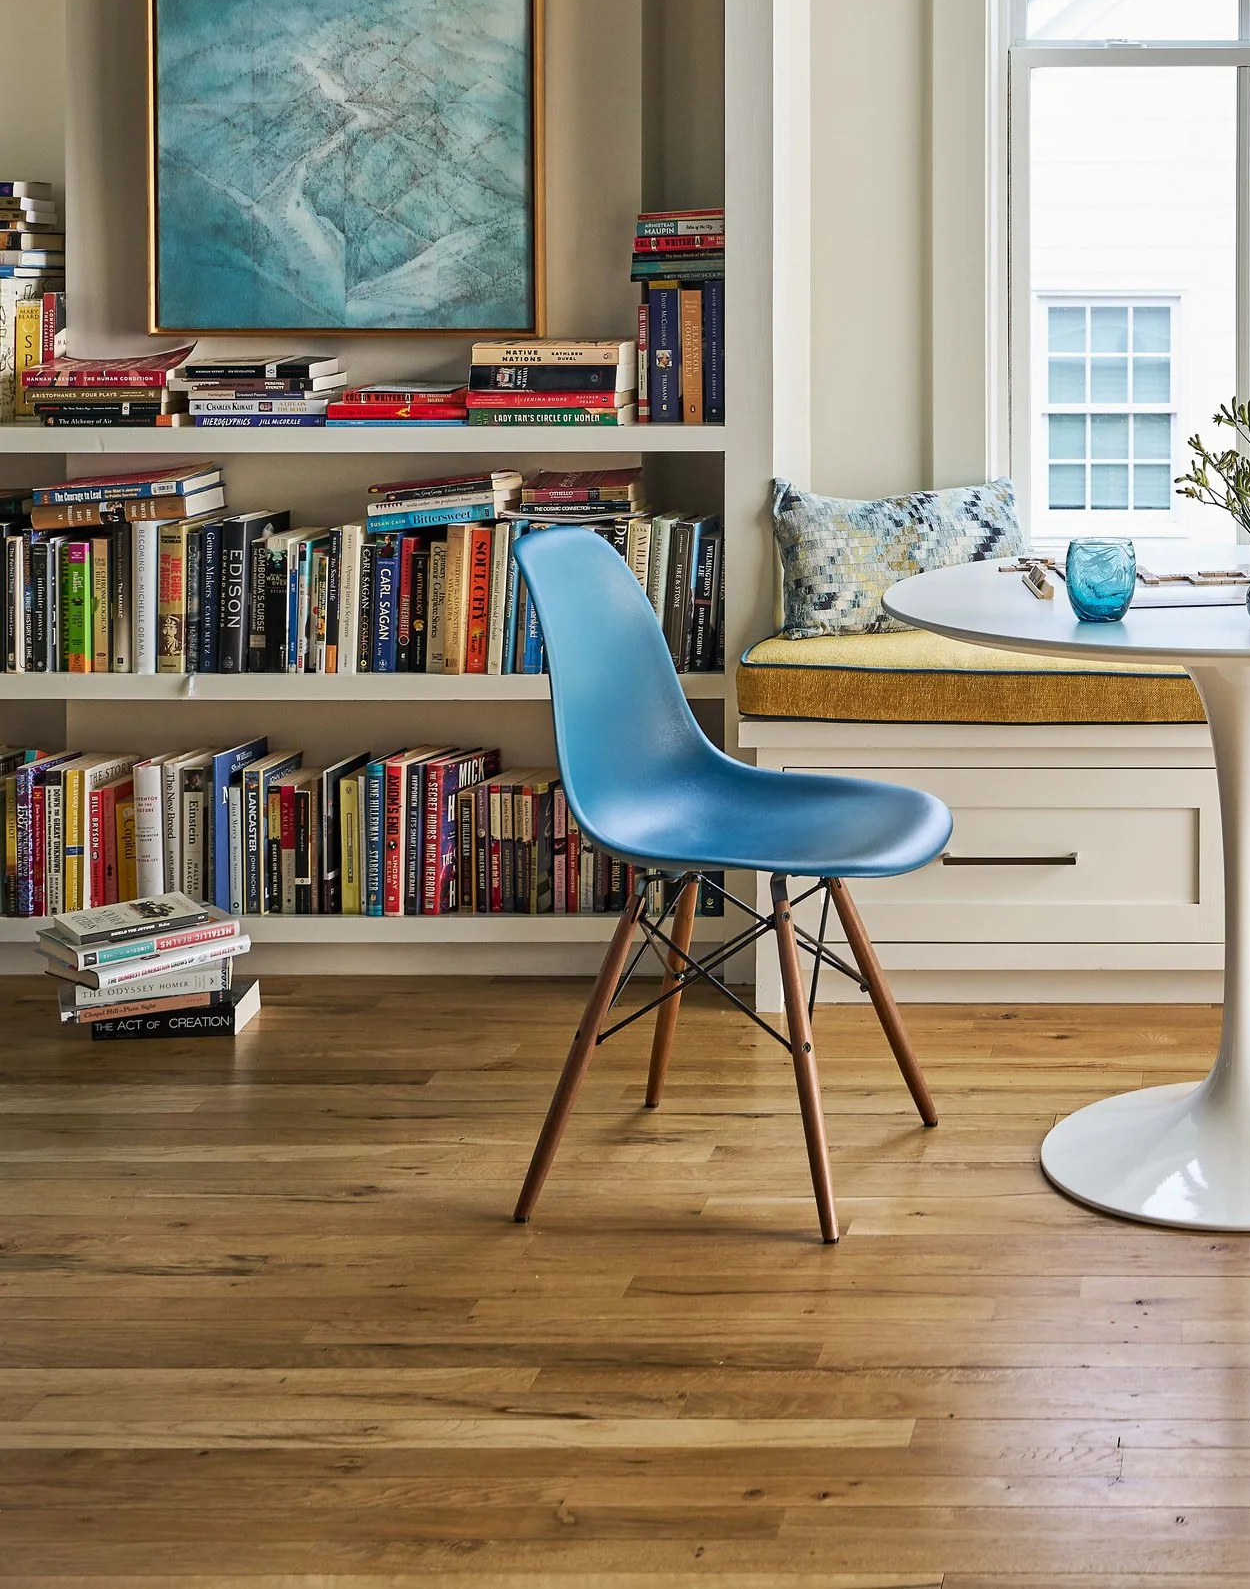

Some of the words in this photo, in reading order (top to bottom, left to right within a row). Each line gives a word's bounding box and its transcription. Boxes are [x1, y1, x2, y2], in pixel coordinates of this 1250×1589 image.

[202, 417, 251, 426] HIEROGLYPHICS
[258, 418, 270, 426] JILL
[494, 414, 513, 422] LADY
[536, 414, 562, 422] CIRCLE
[563, 414, 572, 422] OF
[574, 414, 600, 422] WOMEN
[412, 510, 471, 525] Bittersweet
[138, 529, 146, 572] BECOMING
[159, 554, 171, 568] OF
[471, 540, 487, 583] SOUL
[171, 556, 182, 578] THE
[697, 565, 706, 577] LIE
[703, 545, 715, 597] WILMINGTON'S
[159, 569, 172, 604] AUGUST
[170, 577, 182, 602] GUNS
[227, 549, 243, 629] EDISON
[137, 584, 146, 624] MICHELLE
[471, 585, 487, 623] CITY
[138, 626, 146, 657] OBAMA
[370, 778, 380, 798] ANNE
[429, 771, 437, 780] THE
[91, 796, 100, 814] BILL
[427, 782, 439, 812] SECRET
[91, 818, 100, 849] BRYSON
[247, 792, 258, 852] LANCASTER
[369, 800, 380, 843] HILLERMAN
[426, 814, 438, 840] HOURS
[426, 843, 437, 864] MICK
[368, 849, 379, 891] STARGAZER
[425, 866, 437, 898] HERRON
[81, 990, 103, 999] THE
[107, 984, 155, 996] ODYSSEY
[159, 980, 190, 991] HOMER
[94, 1022, 114, 1032] THE
[118, 1020, 143, 1030] ACT
[146, 1020, 161, 1030] OF
[169, 1016, 230, 1029] CREATION
